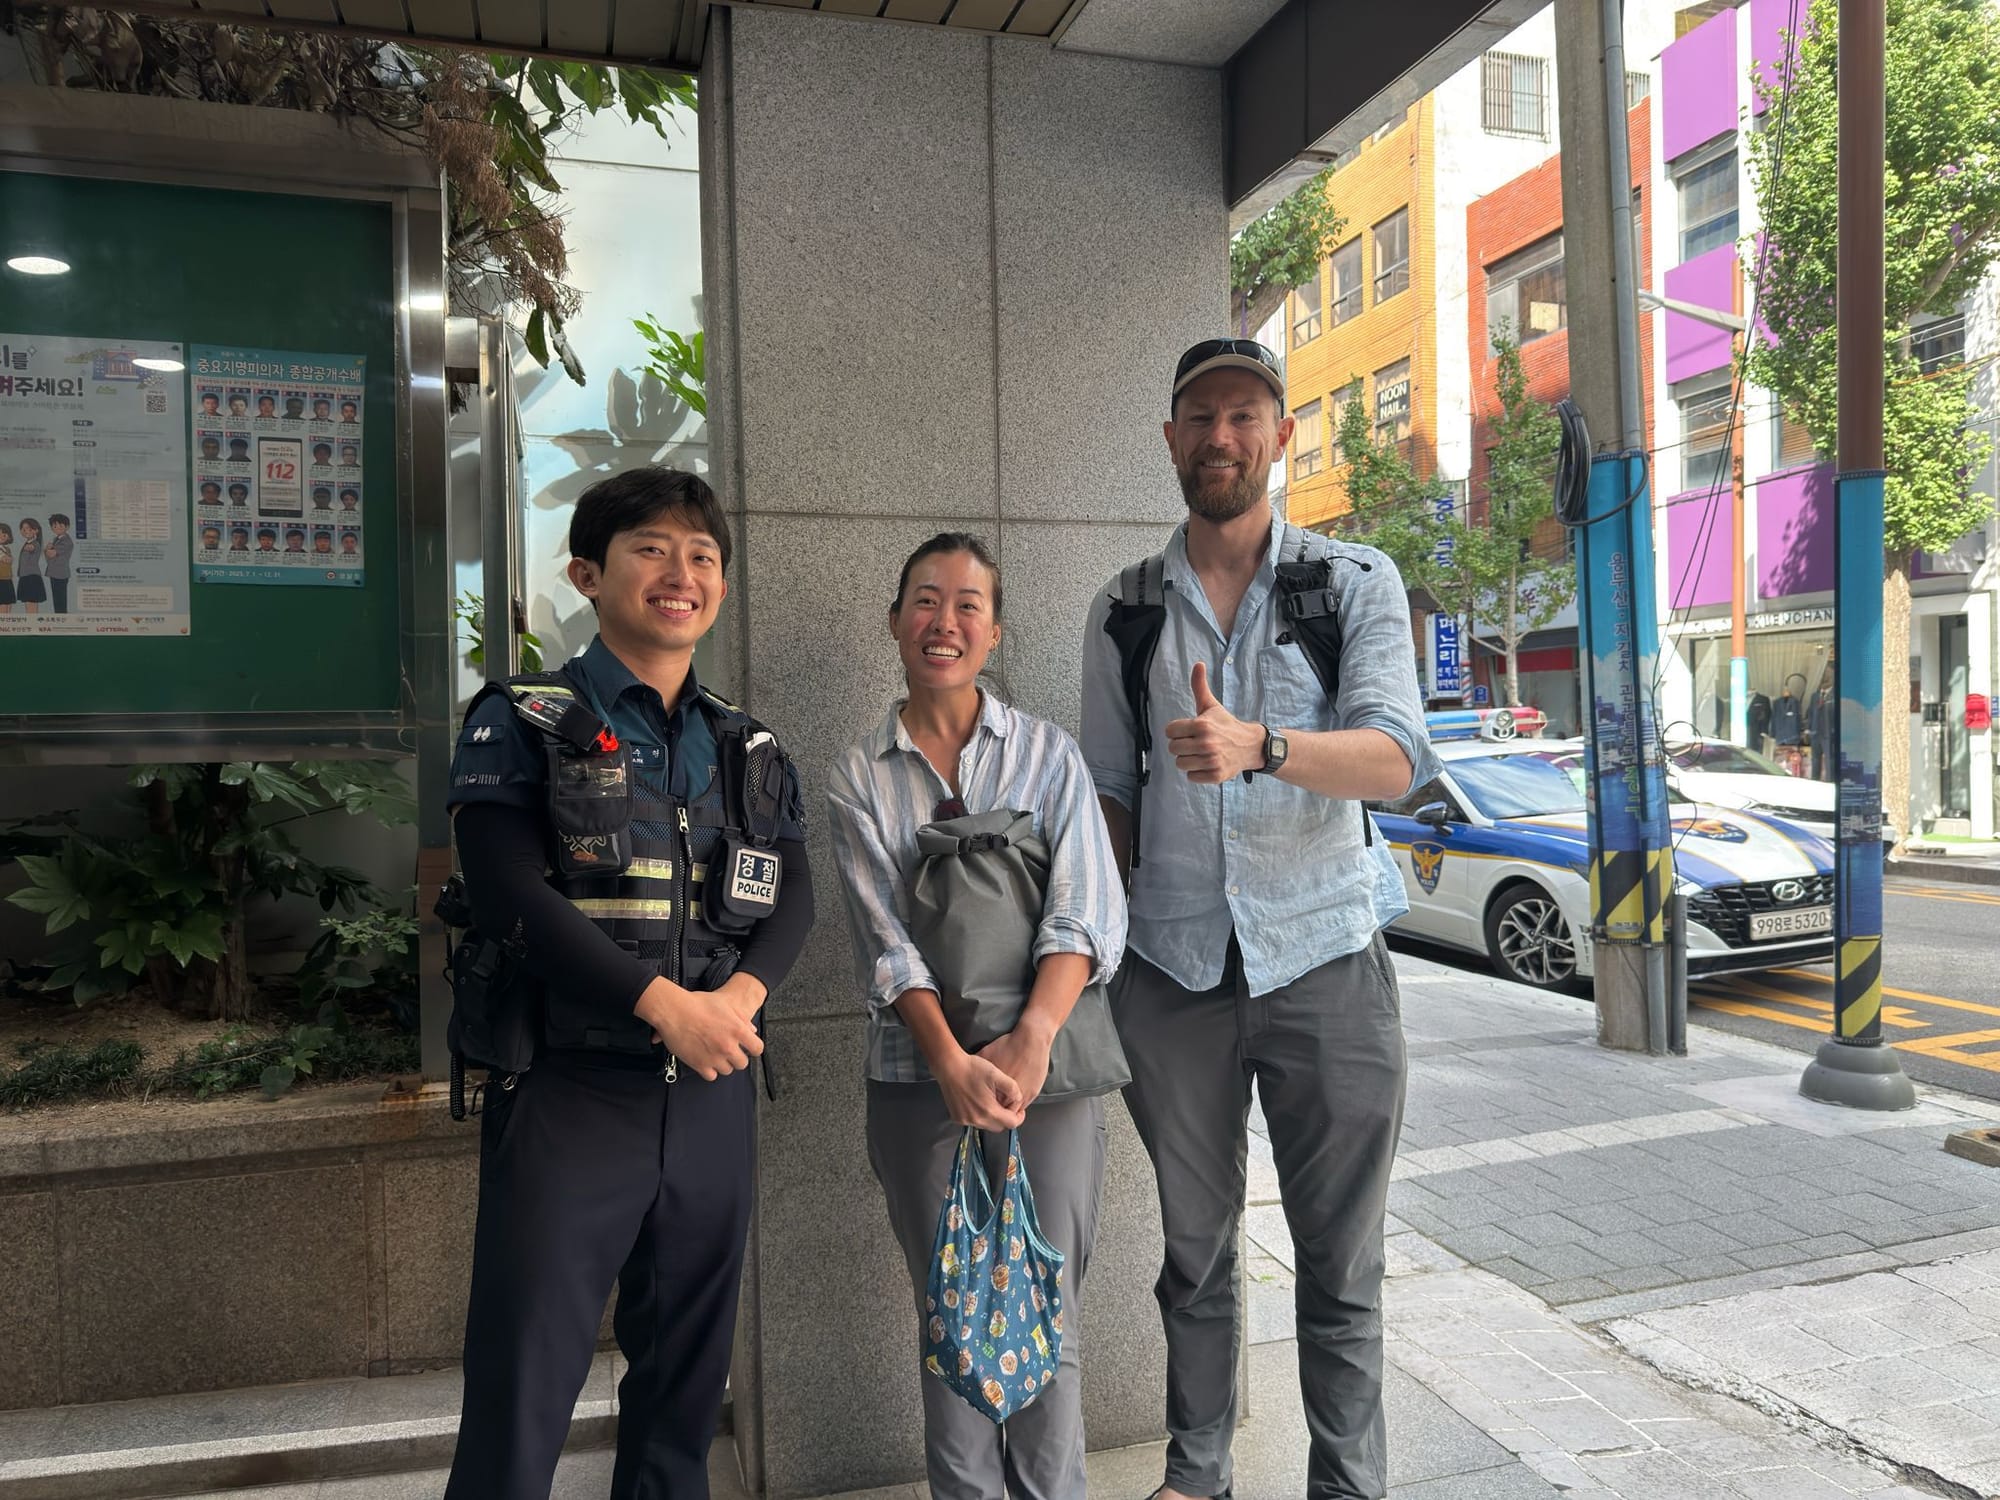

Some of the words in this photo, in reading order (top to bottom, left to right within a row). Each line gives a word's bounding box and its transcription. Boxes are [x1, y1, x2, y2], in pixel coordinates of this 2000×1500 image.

[197, 358, 283, 379] 중요지명피의자
[289, 364, 361, 383] 종합공개수배
[1380, 382, 1407, 404] NOON
[267, 463, 295, 480] 112
[741, 855, 775, 883] 경찰
[737, 882, 772, 897] POLICE
[1757, 917, 1792, 934] 998로
[1795, 911, 1827, 930] 5320
